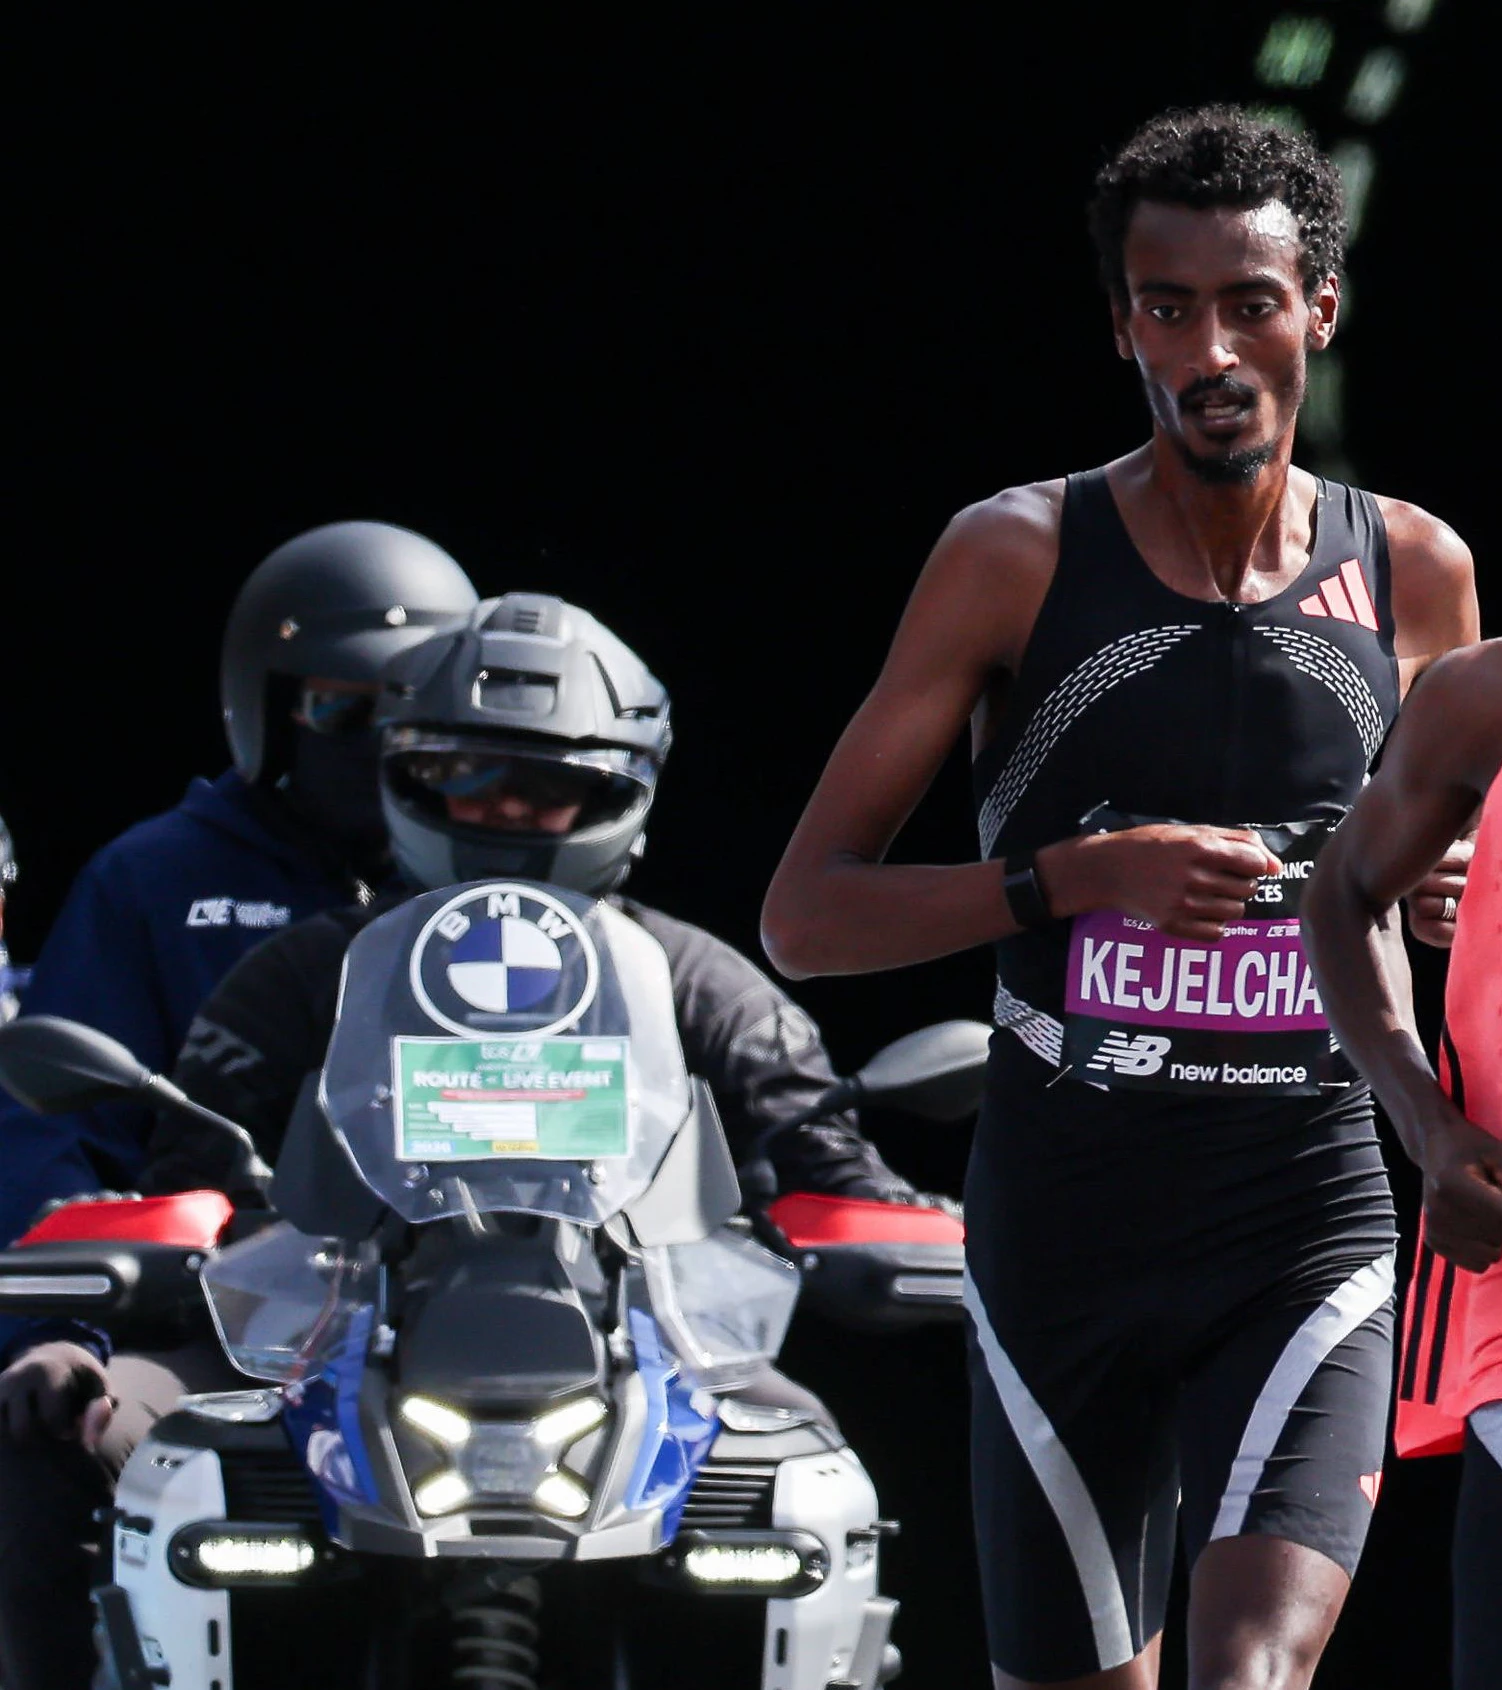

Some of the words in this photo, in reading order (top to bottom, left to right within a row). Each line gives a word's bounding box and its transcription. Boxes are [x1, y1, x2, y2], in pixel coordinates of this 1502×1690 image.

[436, 893, 573, 942] BMW
[1080, 937, 1323, 1018] KEJELCHA
[502, 1070, 544, 1089] LIVE
[548, 1070, 613, 1089] EVENT
[1170, 1063, 1217, 1083] new
[1222, 1064, 1307, 1084] balance
